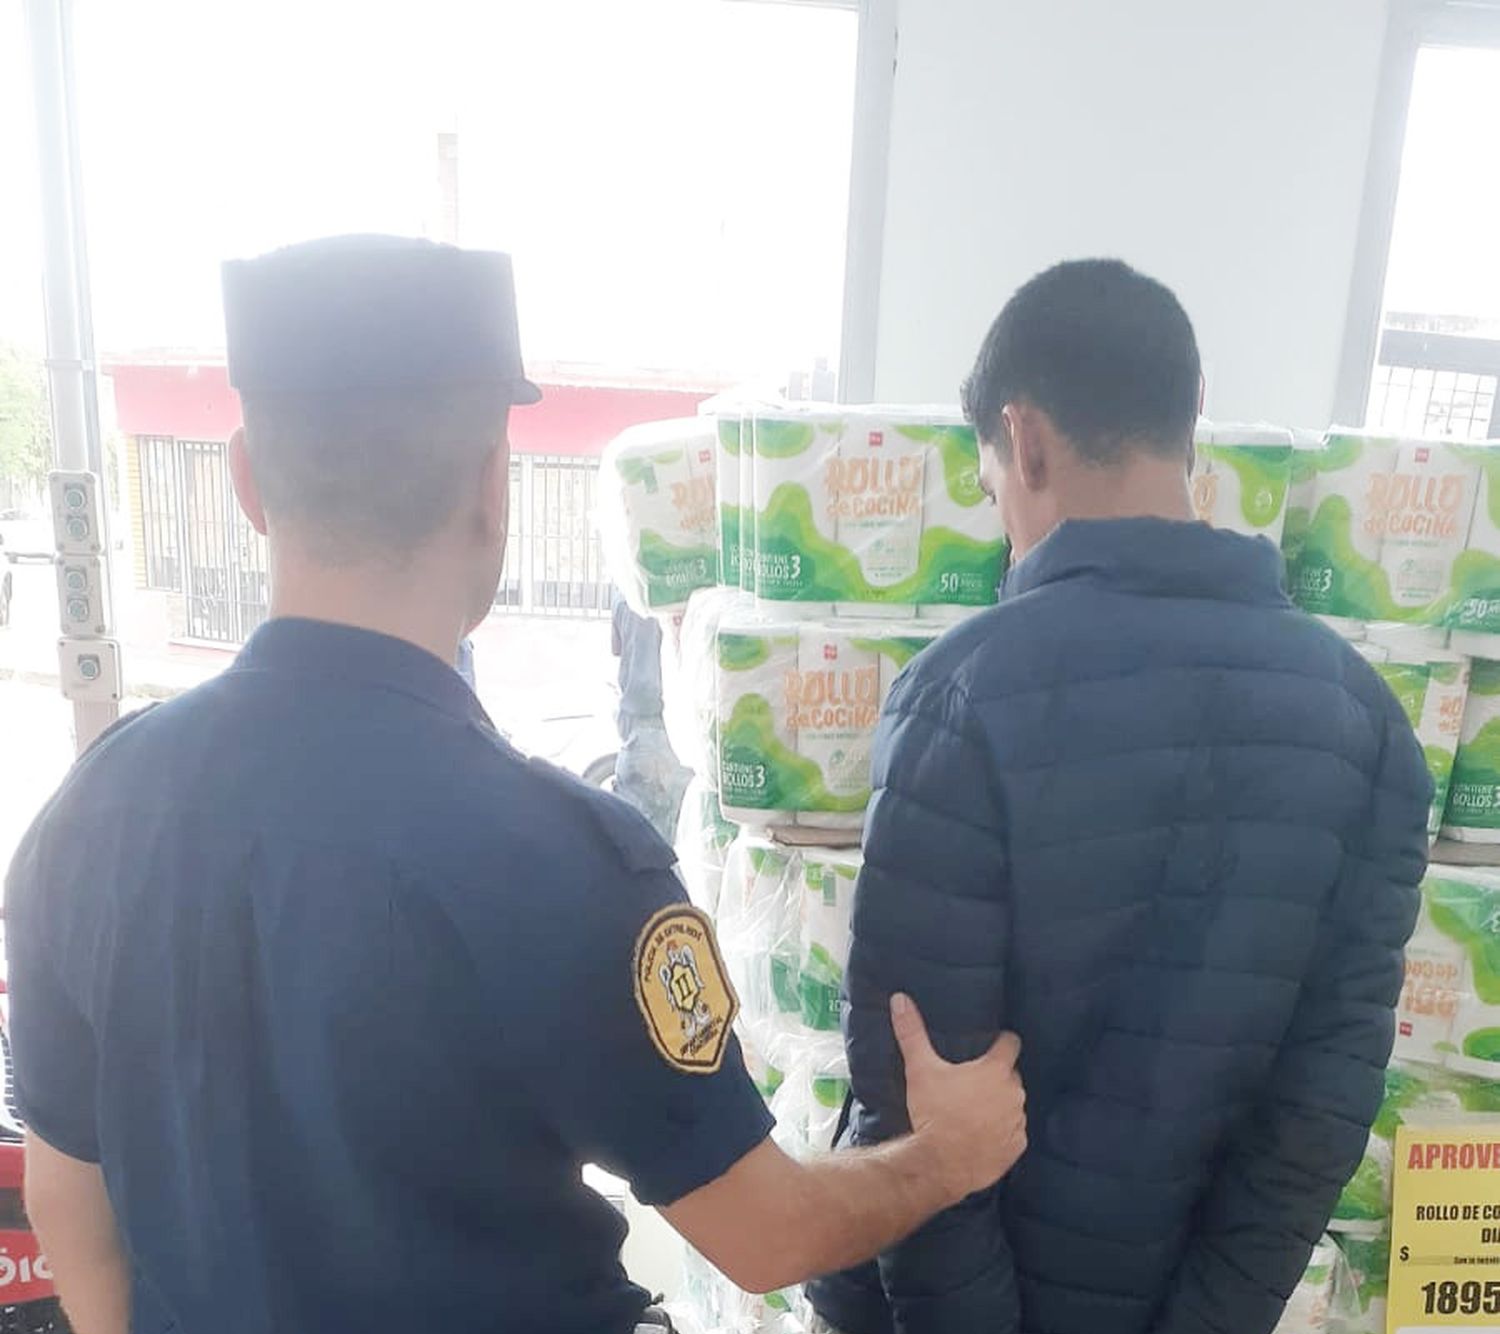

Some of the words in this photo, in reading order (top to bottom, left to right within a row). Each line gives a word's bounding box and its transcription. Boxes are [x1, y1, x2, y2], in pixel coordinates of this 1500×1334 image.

[1368, 472, 1466, 514] ROLLO
[791, 554, 801, 579] 3
[940, 572, 959, 593] 50
[755, 765, 765, 788] 3
[1416, 1205, 1459, 1221] ROLLO
[1462, 1205, 1480, 1221] DE
[1400, 1246, 1410, 1261] $
[1421, 1281, 1500, 1315] 1895
